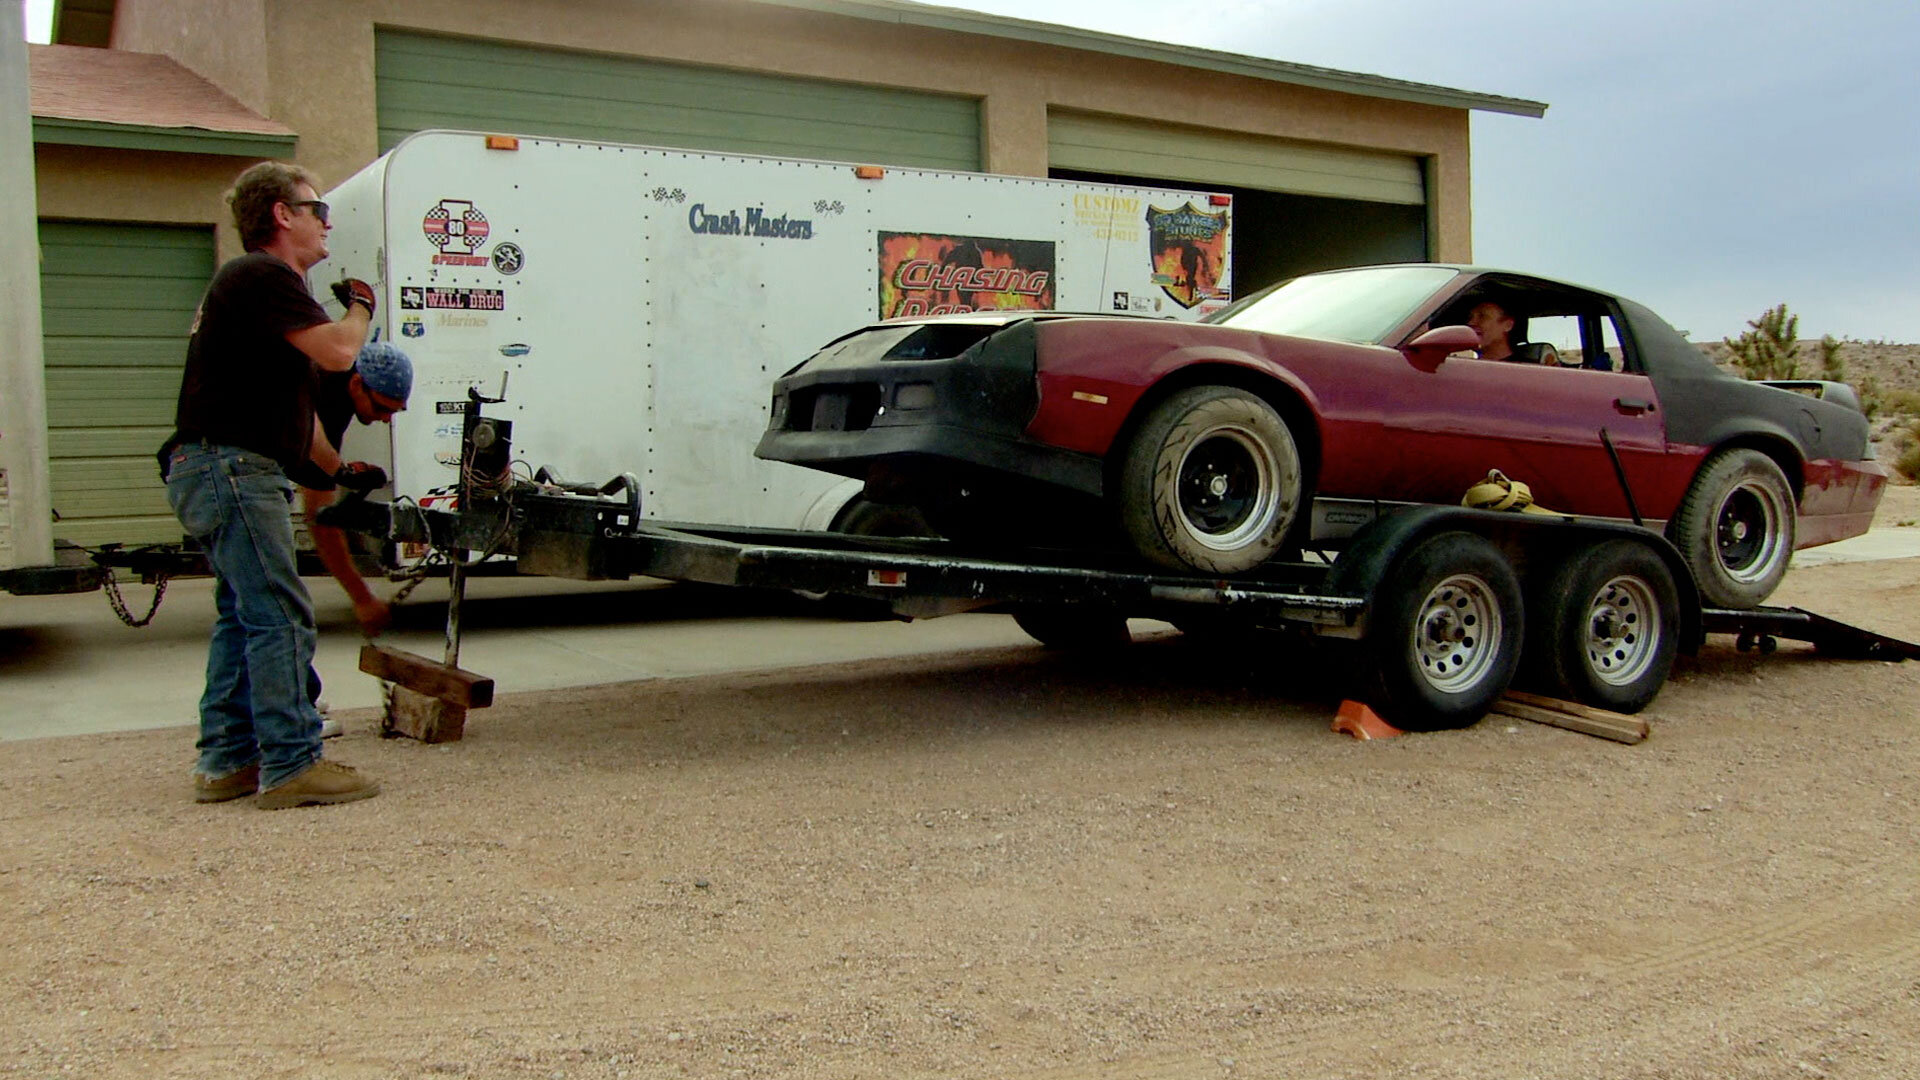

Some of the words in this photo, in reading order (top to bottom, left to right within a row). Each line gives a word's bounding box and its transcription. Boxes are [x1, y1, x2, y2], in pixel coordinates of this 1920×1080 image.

[449, 221, 465, 236] 80
[689, 203, 740, 235] Crash
[744, 207, 813, 239] Masters
[432, 255, 489, 266] SPEEDWAY
[899, 260, 1048, 294] CHASING
[427, 293, 464, 308] WALL
[469, 294, 502, 309] DRUG
[437, 312, 488, 327] Marines
